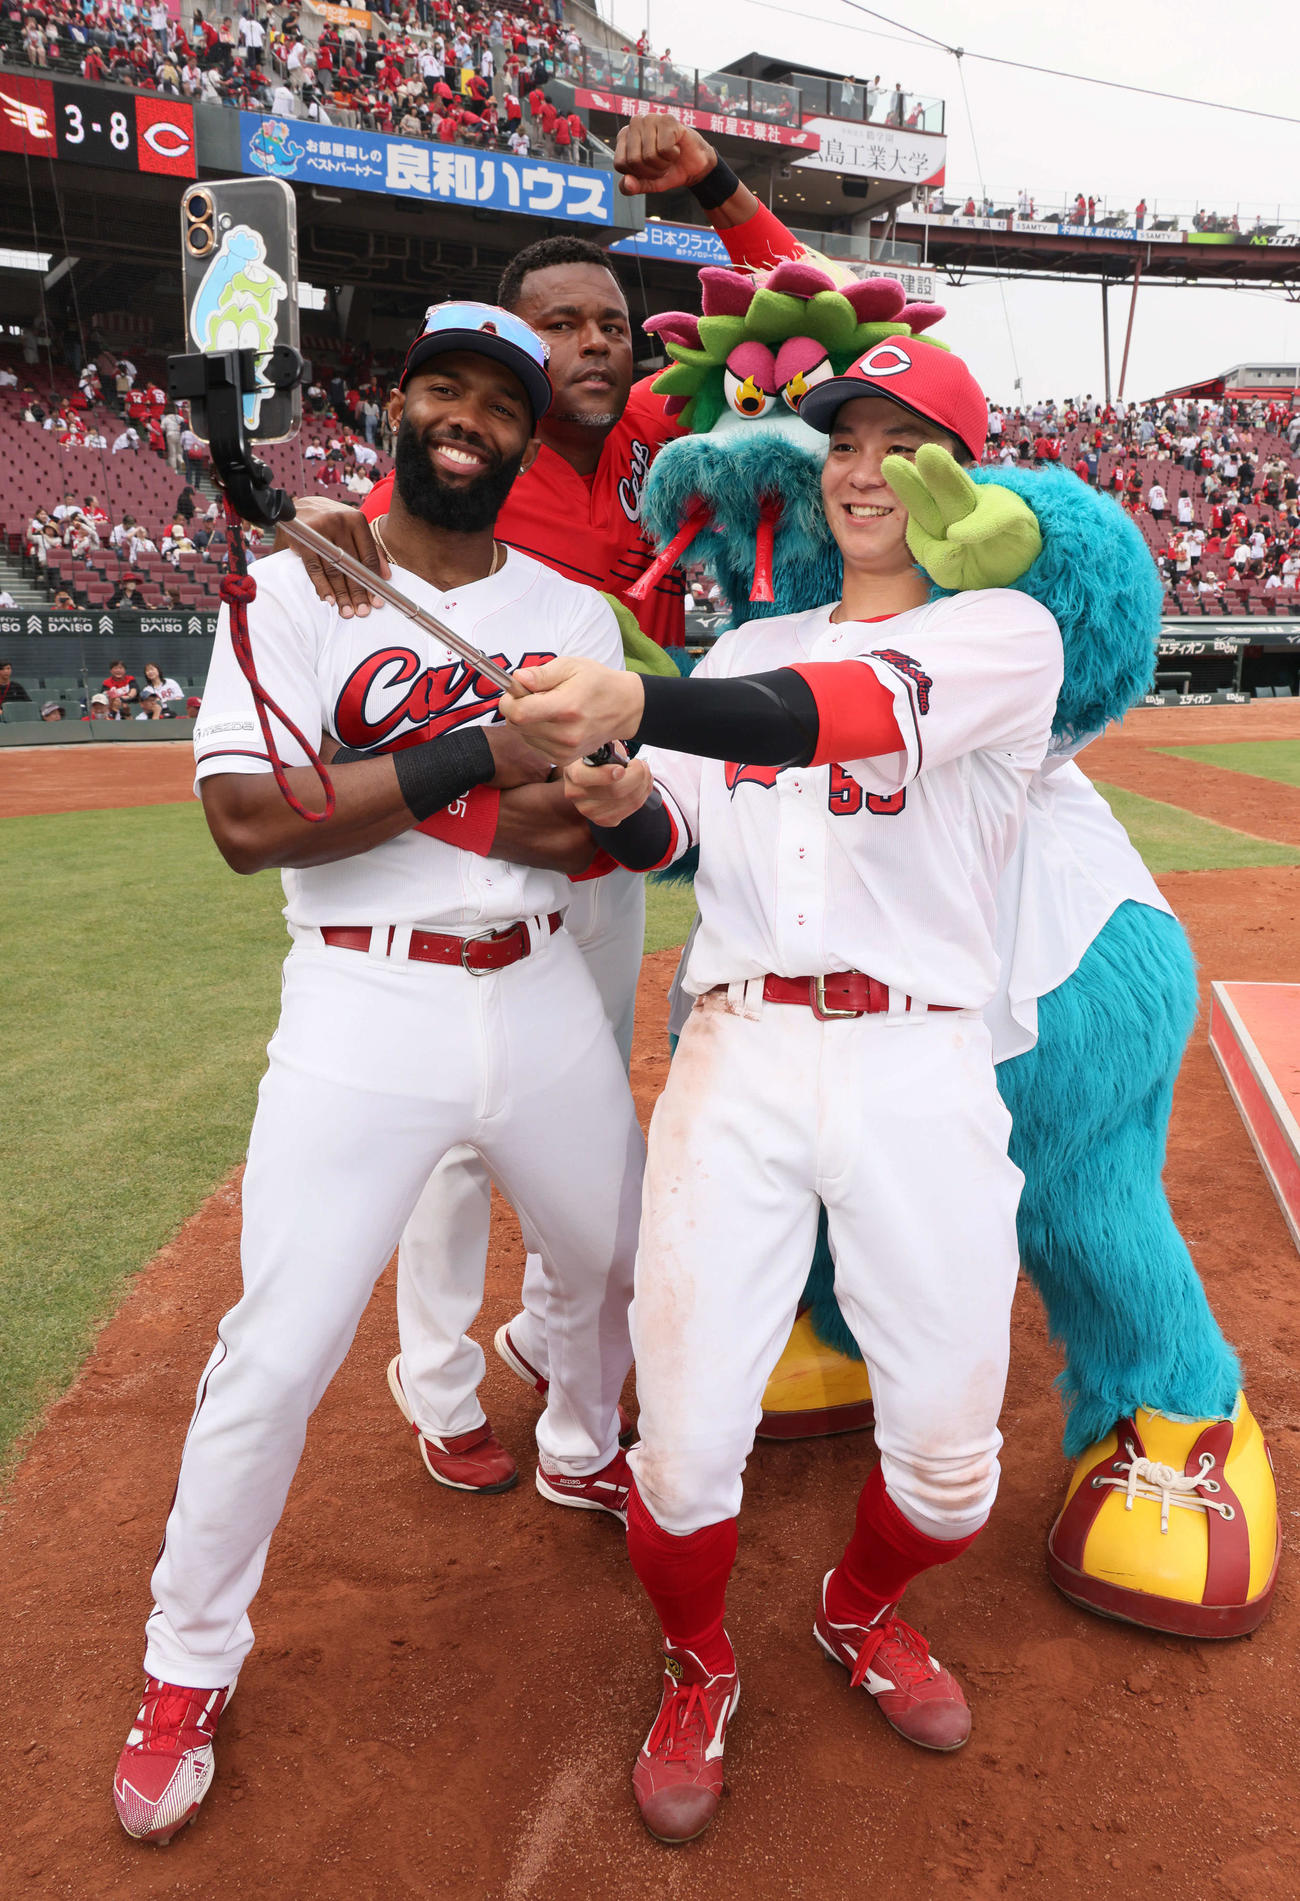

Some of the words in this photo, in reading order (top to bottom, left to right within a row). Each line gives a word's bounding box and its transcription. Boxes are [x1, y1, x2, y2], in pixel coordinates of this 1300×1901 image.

[710, 114, 781, 144] 新星工業社
[305, 138, 383, 163] お部屋探しの
[306, 157, 384, 178] ベストパートナー
[385, 143, 608, 221] 良和ハウス
[0, 623, 21, 632] SO
[48, 623, 93, 632] DAISO
[141, 624, 183, 633] DAISO
[1159, 642, 1205, 655] エディオン
[1180, 694, 1212, 705] エディオン
[447, 789, 470, 818] 5
